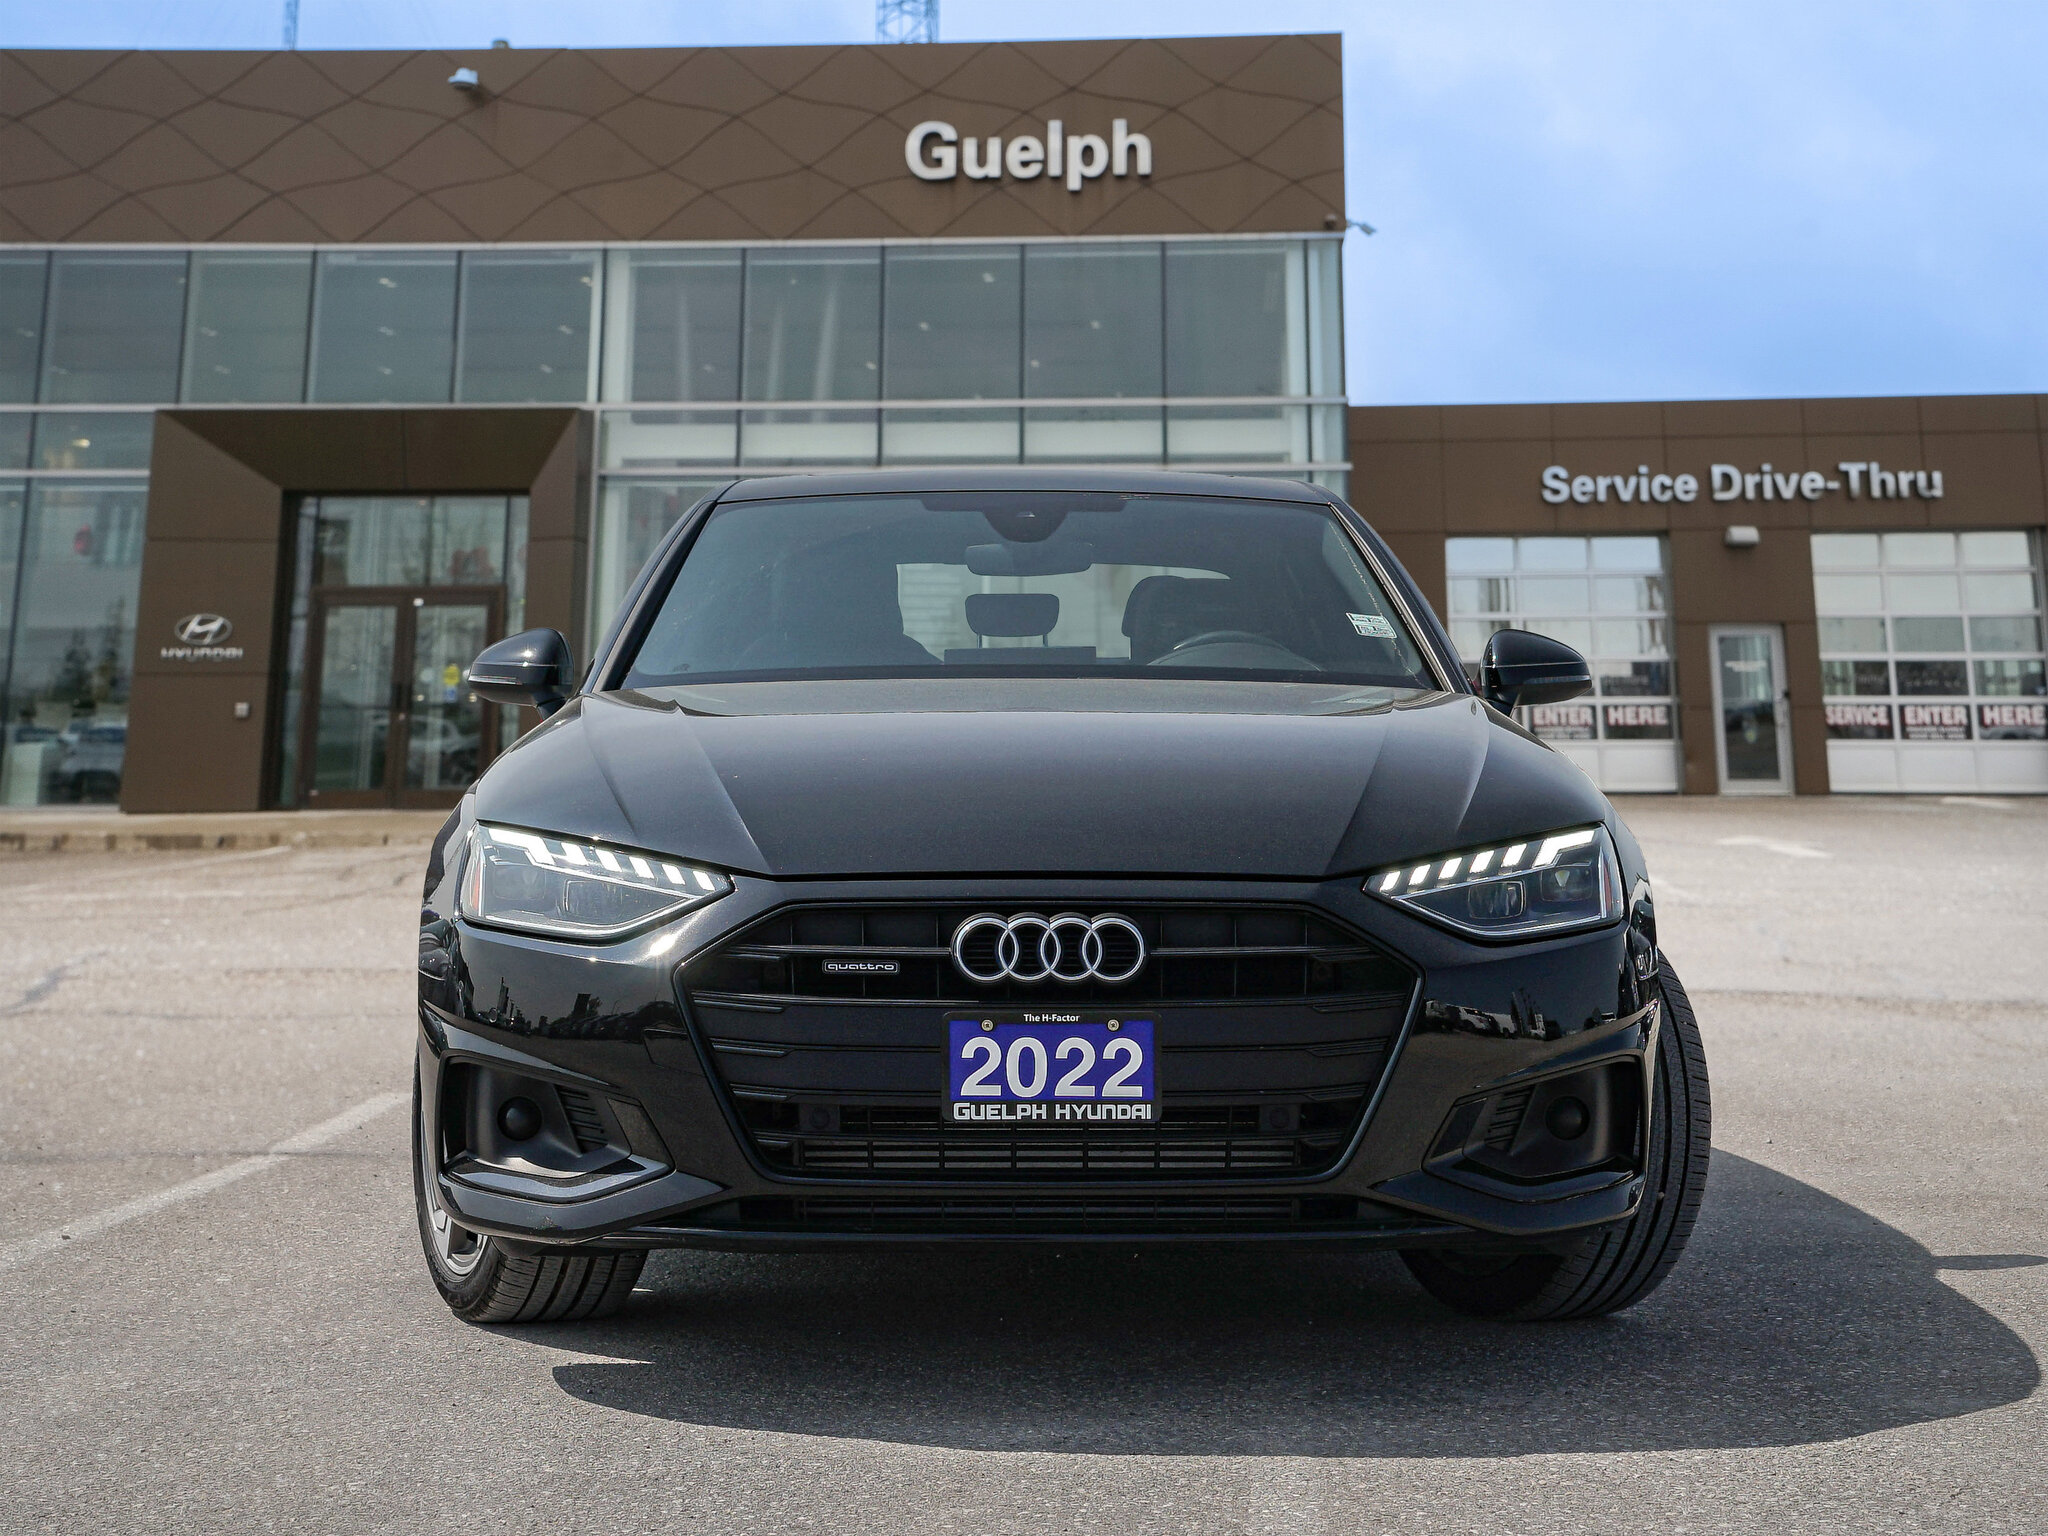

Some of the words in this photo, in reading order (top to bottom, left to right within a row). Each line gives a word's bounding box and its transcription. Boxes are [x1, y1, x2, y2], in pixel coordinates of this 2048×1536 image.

[904, 118, 1152, 192] Guelph
[1541, 464, 1699, 503] Service
[1710, 461, 1944, 501] Drive-Thru
[1533, 706, 1593, 726] ENTER
[1607, 706, 1668, 726] HERE
[1825, 705, 1889, 726] SERVICE
[1903, 705, 1968, 726] ENTER
[1983, 705, 2047, 726] HERE
[827, 963, 894, 971] quattro
[1023, 1013, 1040, 1022] The
[1042, 1013, 1080, 1022] H-Factor
[960, 1036, 1144, 1098] 2022
[953, 1102, 1047, 1120] GUELPH
[1055, 1103, 1151, 1120] HYUNDAI
